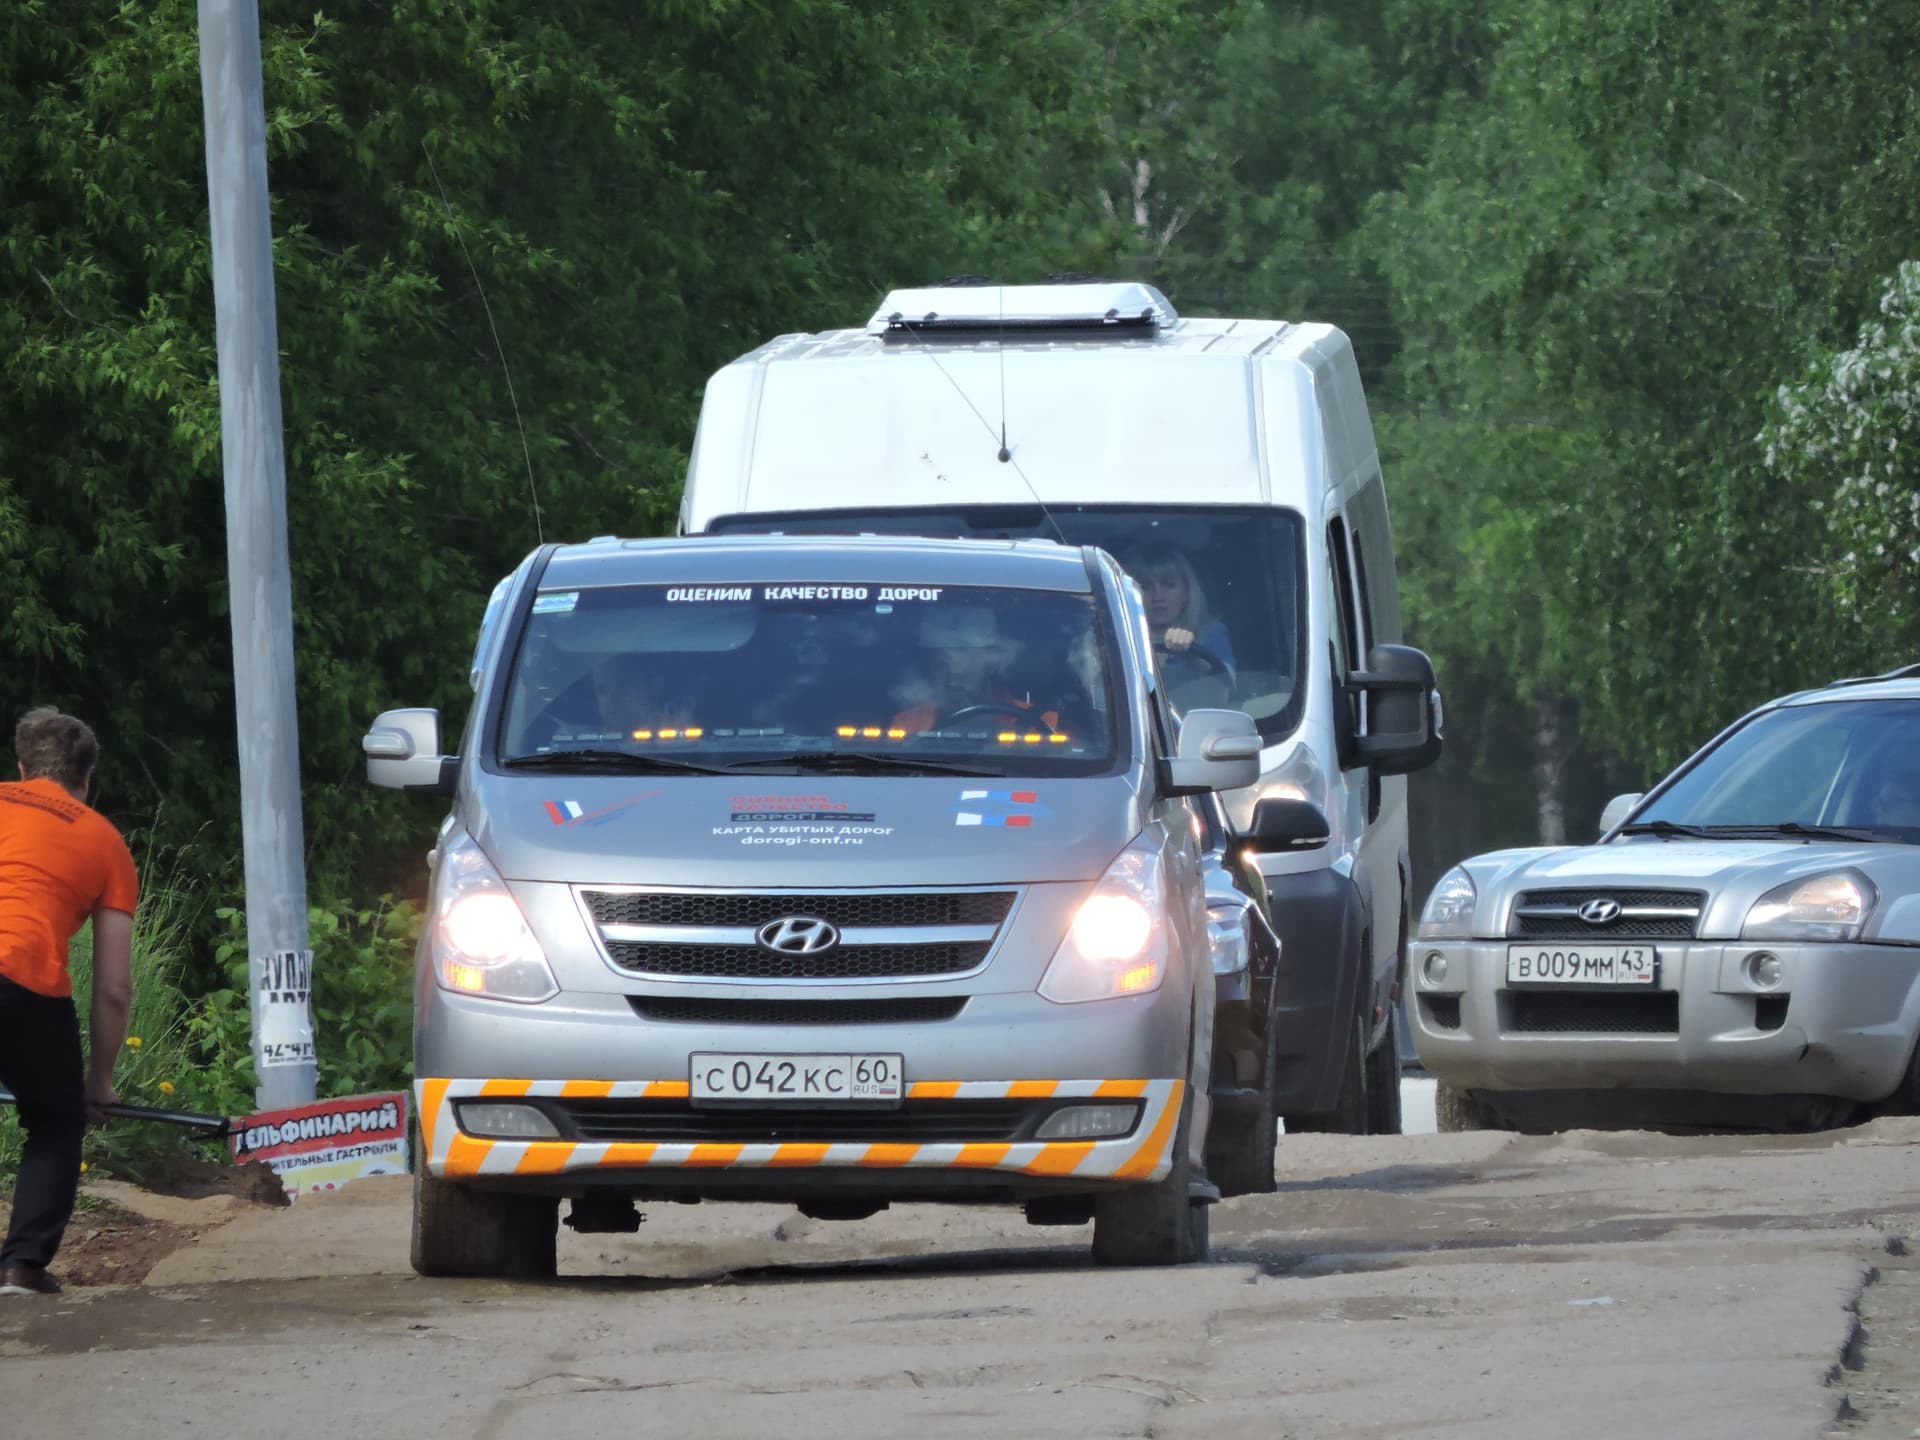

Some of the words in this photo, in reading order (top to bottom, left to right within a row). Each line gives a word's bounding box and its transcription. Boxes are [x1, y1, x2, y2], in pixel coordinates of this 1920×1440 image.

[666, 587, 752, 602] ОЦЕНИМ
[764, 586, 868, 600] КАЧЕСТВО
[877, 587, 943, 601] ДОРОГ
[712, 826, 765, 836] КАРТА
[769, 826, 835, 834] УБИТЫХ
[838, 826, 896, 836] ДОРОГ
[741, 835, 863, 846] dorogi-onf.ru
[1620, 949, 1645, 971] 43
[855, 1058, 889, 1083] 60
[853, 1085, 878, 1095] RUS
